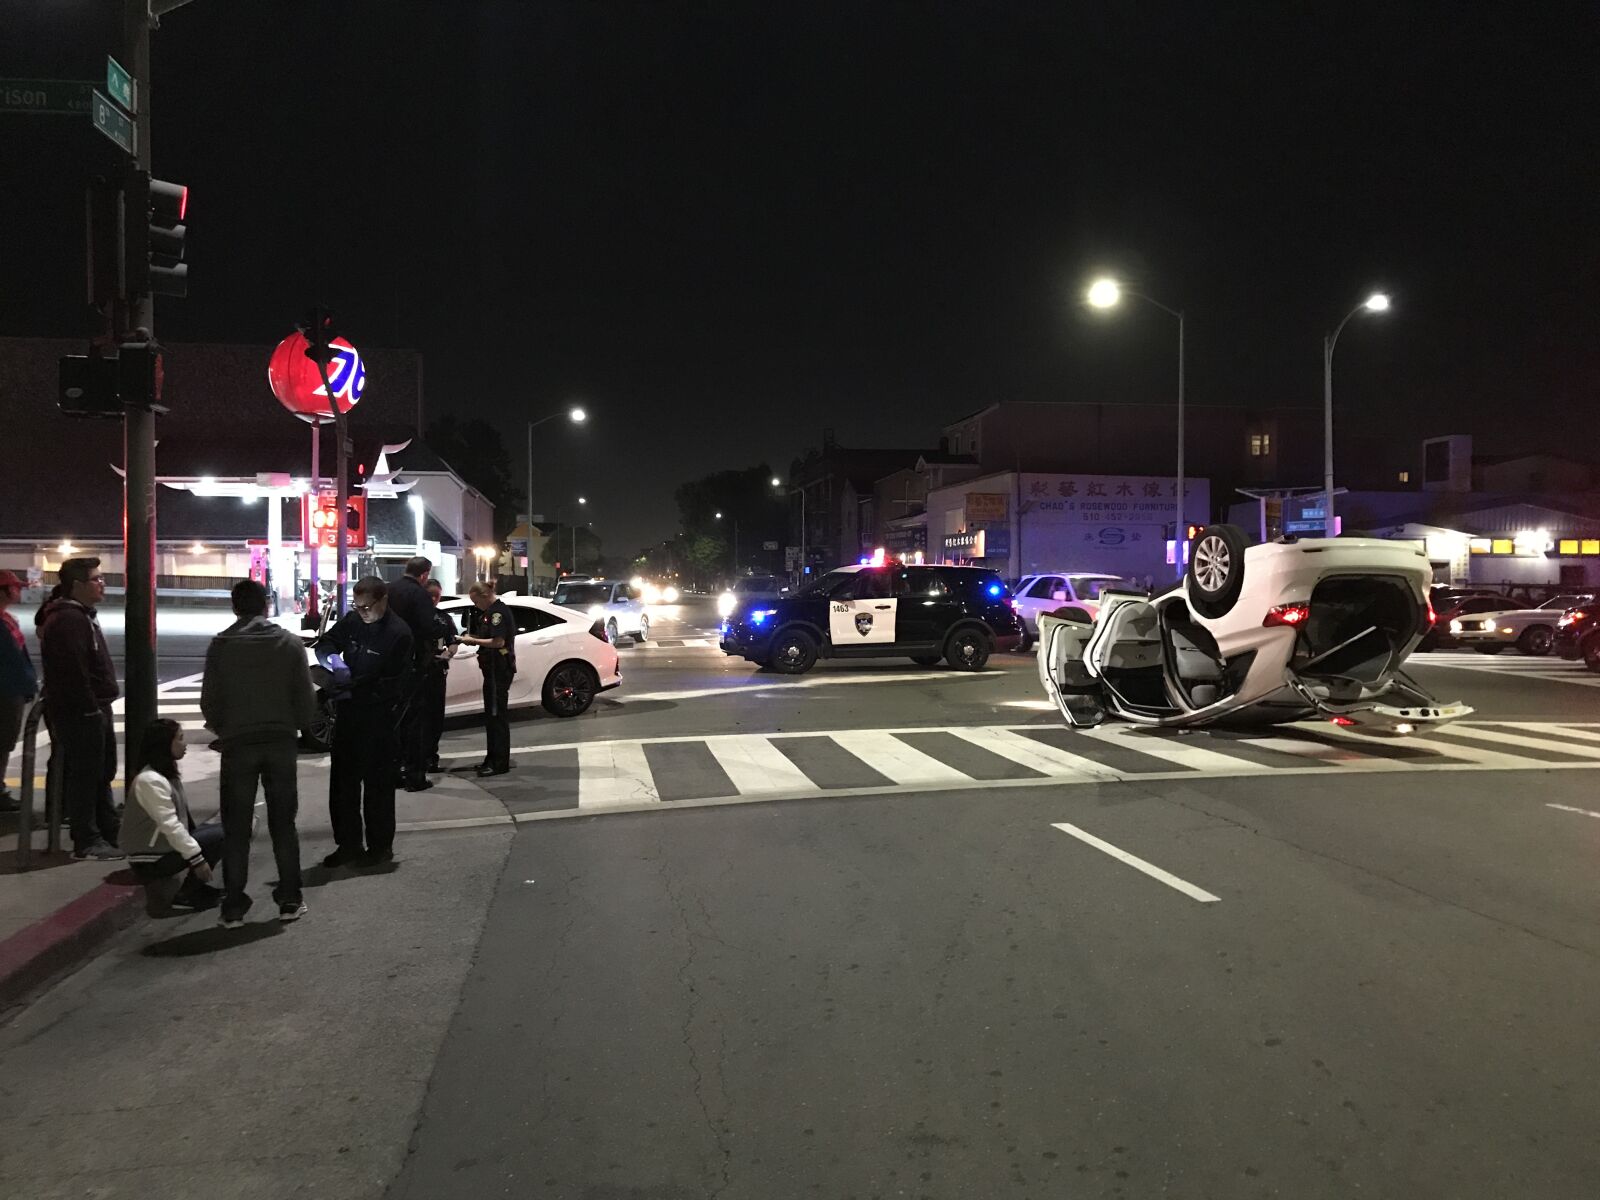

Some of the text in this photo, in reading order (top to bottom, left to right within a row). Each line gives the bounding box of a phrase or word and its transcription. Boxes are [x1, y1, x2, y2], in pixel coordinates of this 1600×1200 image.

[1080, 502, 1128, 511] ROSEWOOD
[1133, 503, 1178, 512] FURNITUR
[833, 604, 849, 613] 1463
